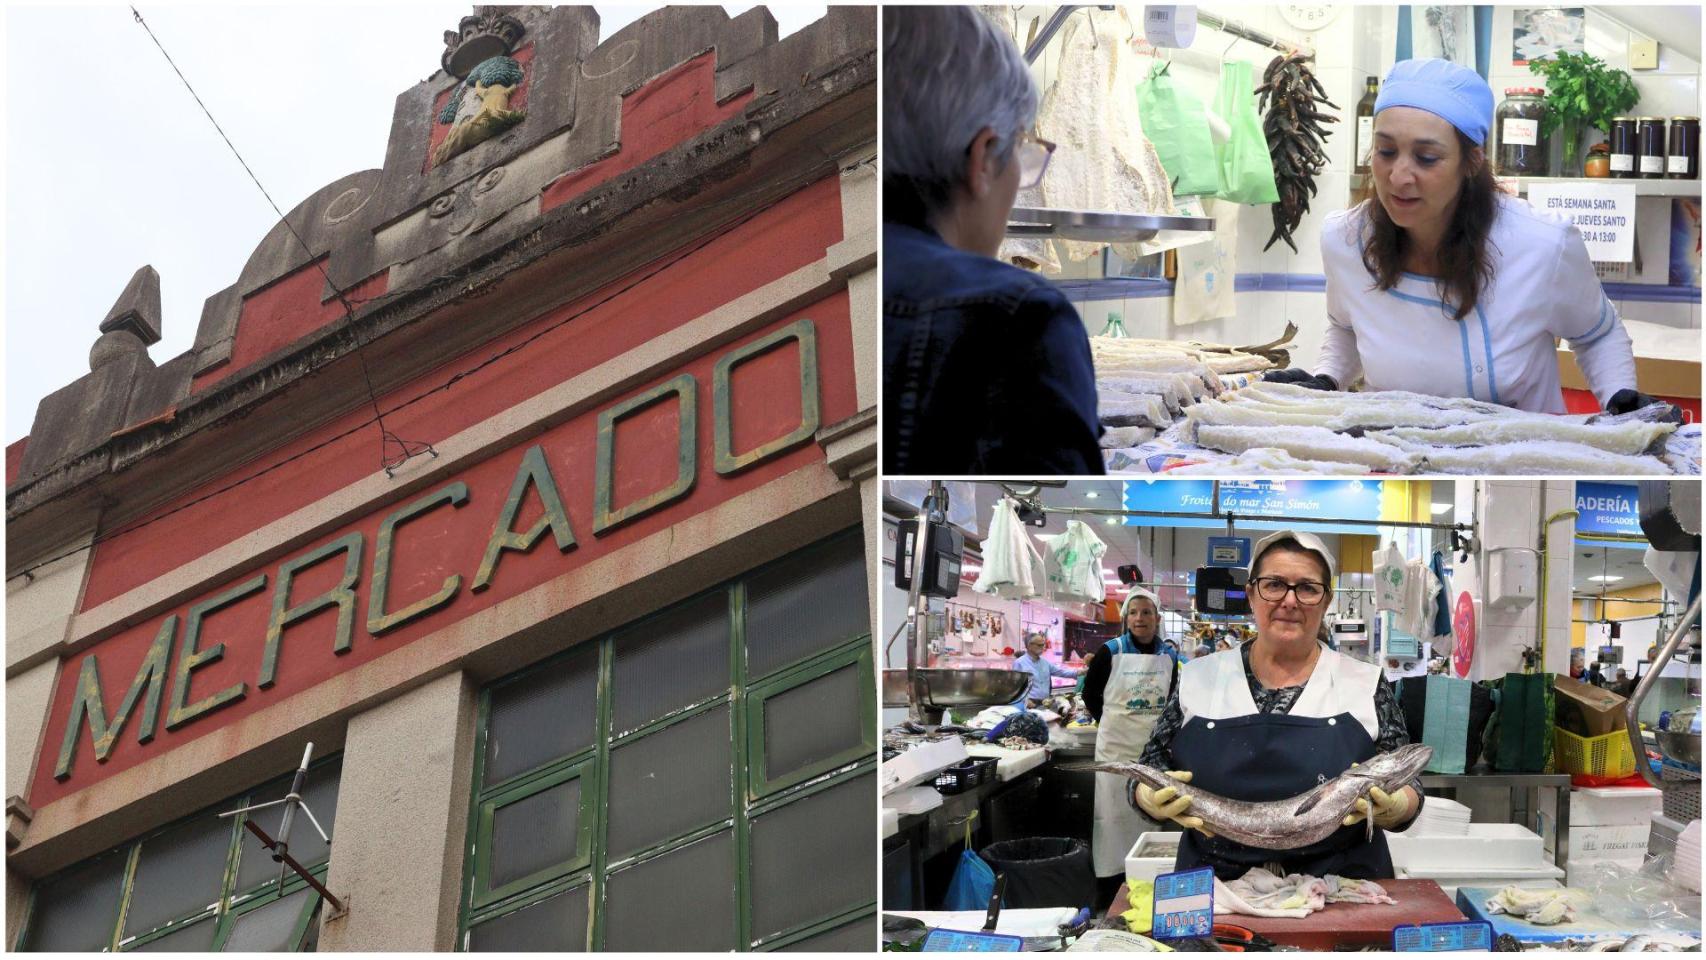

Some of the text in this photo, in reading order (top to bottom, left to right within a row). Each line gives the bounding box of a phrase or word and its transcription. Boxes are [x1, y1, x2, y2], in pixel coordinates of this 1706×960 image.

[1547, 195, 1617, 210] ESTÁ SEMANA SANTA
[1576, 214, 1602, 226] JUEVES
[1603, 216, 1626, 227] SANTO
[1592, 232, 1598, 242] A
[1599, 232, 1617, 243] 13:00
[1223, 496, 1237, 506] do
[1240, 499, 1261, 507] mar
[1262, 498, 1284, 508] San
[1286, 498, 1321, 511] Simón
[1575, 495, 1631, 513] ADERÍA
[1596, 515, 1634, 526] PESCADOS
[53, 318, 821, 781] MERCADO
